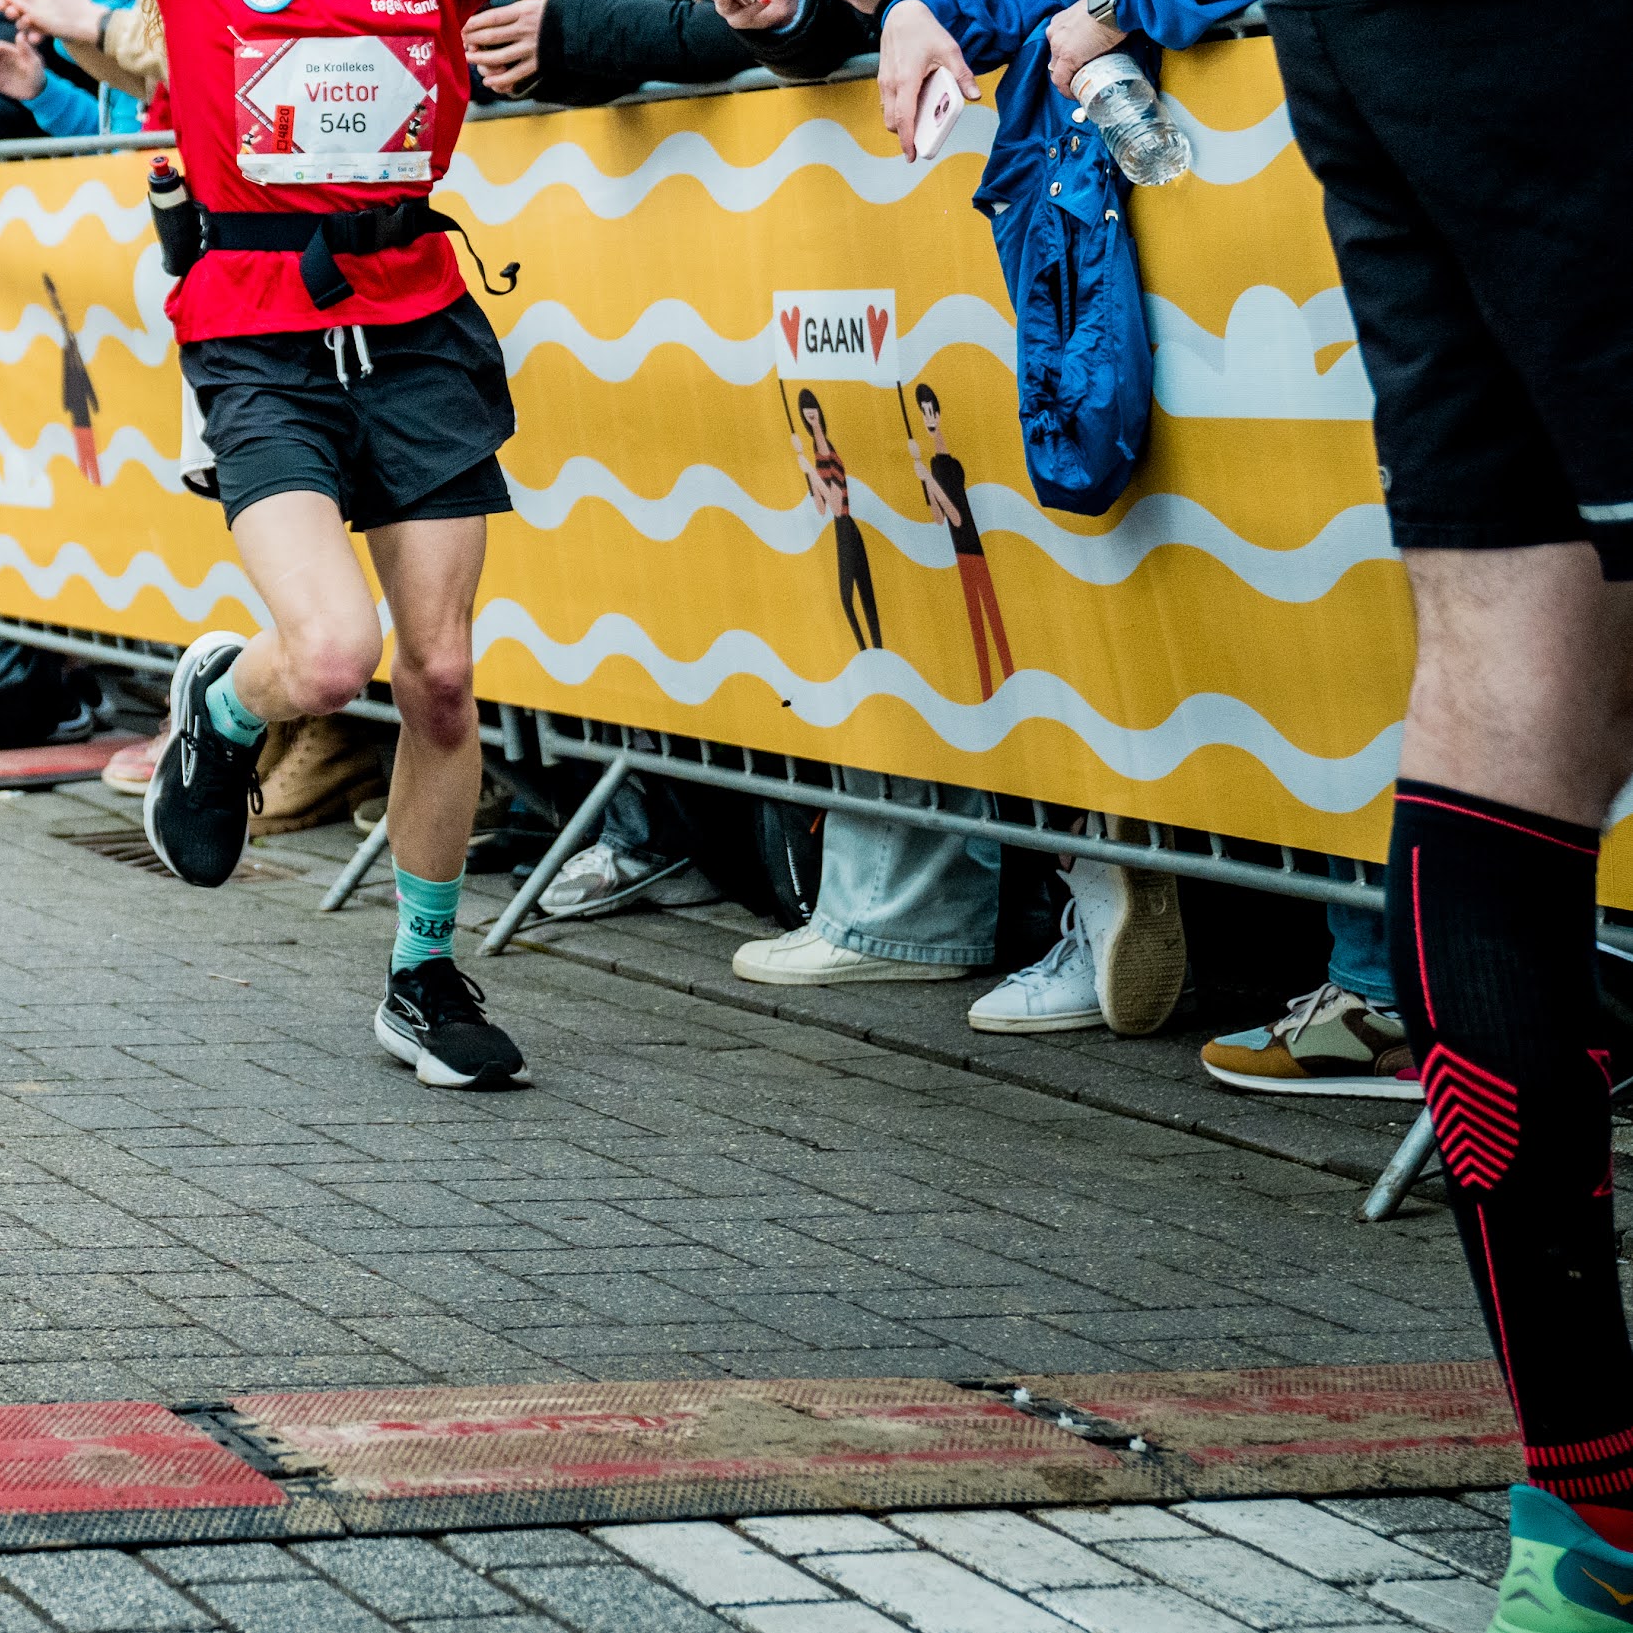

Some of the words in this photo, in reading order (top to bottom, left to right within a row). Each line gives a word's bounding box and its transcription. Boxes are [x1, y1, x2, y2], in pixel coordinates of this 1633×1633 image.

[408, 43, 433, 60] 40
[305, 63, 320, 73] De
[323, 62, 375, 73] Krollekes
[304, 81, 379, 103] Victor
[319, 112, 367, 134] 546
[803, 316, 865, 354] GAAN
